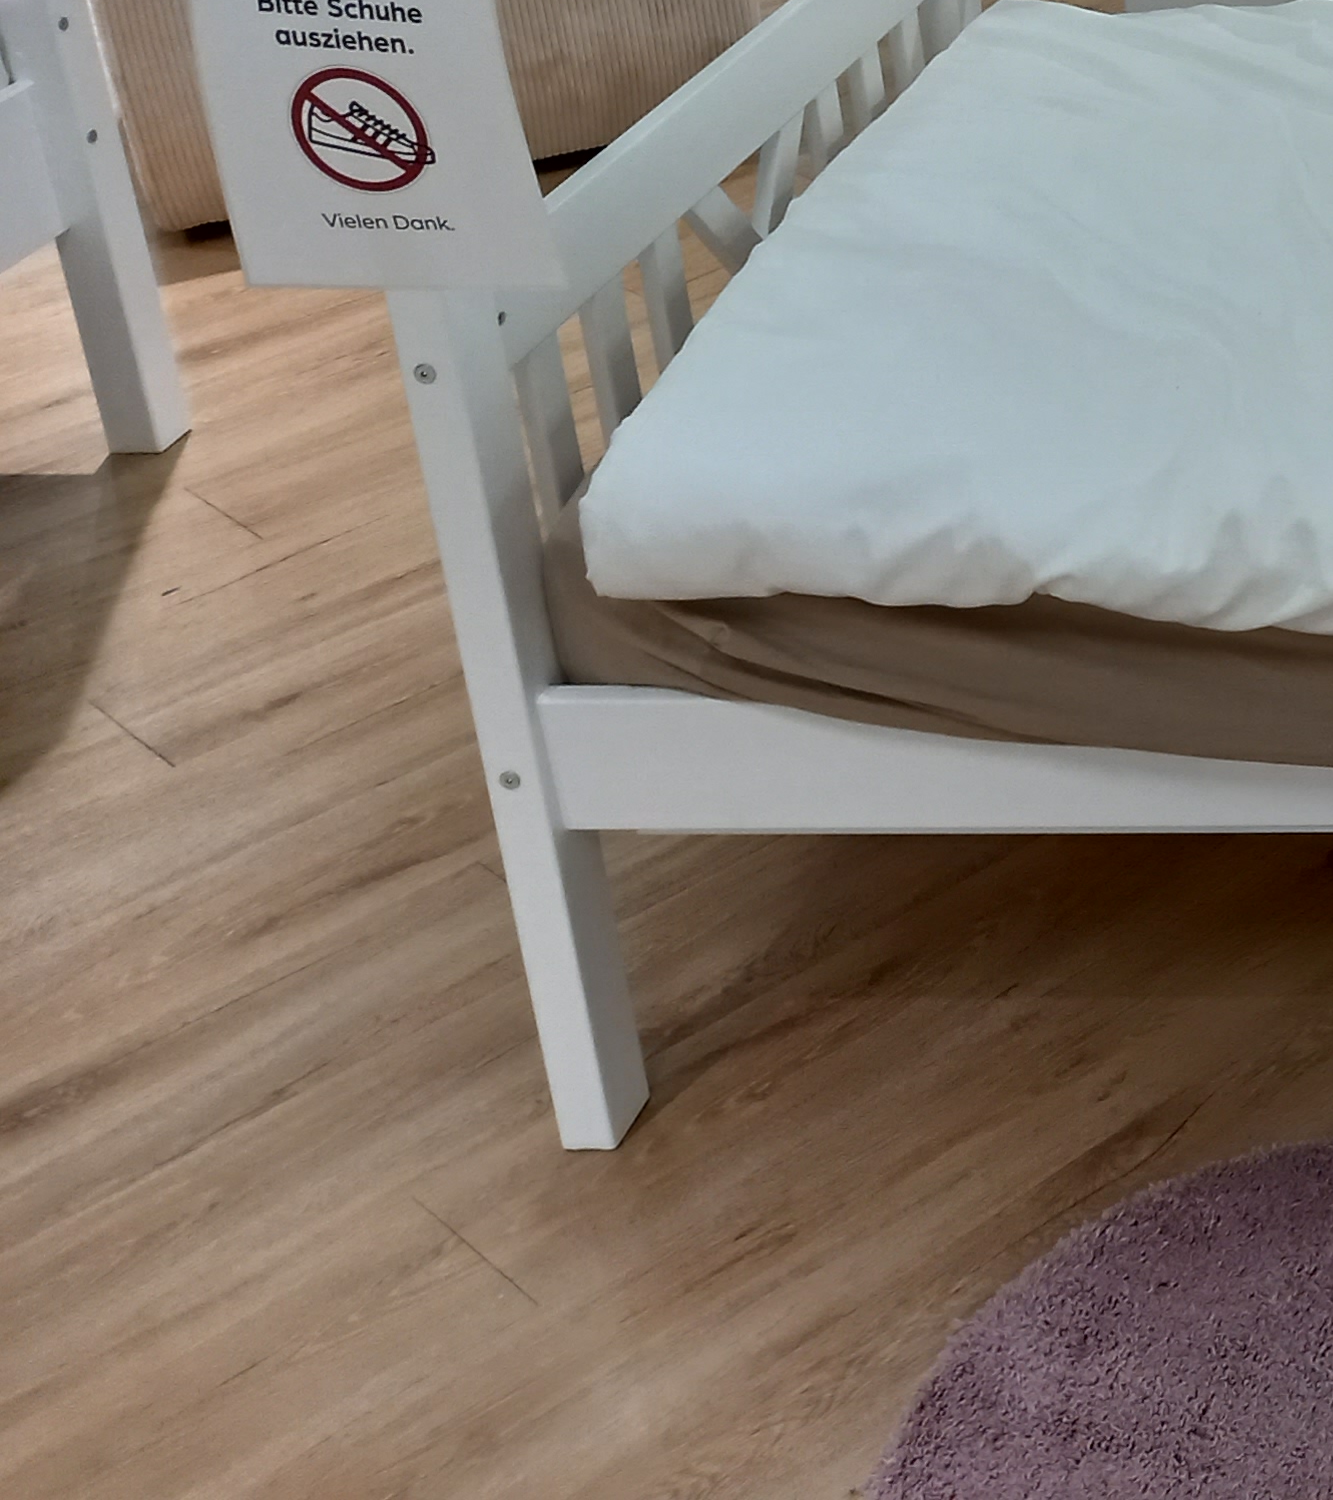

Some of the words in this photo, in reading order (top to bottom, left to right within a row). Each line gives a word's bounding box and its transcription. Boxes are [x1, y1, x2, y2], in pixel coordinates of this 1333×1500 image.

[276, 28, 415, 55] ausziehen.
[322, 213, 388, 230] Vielen
[393, 215, 456, 232] Dank.
